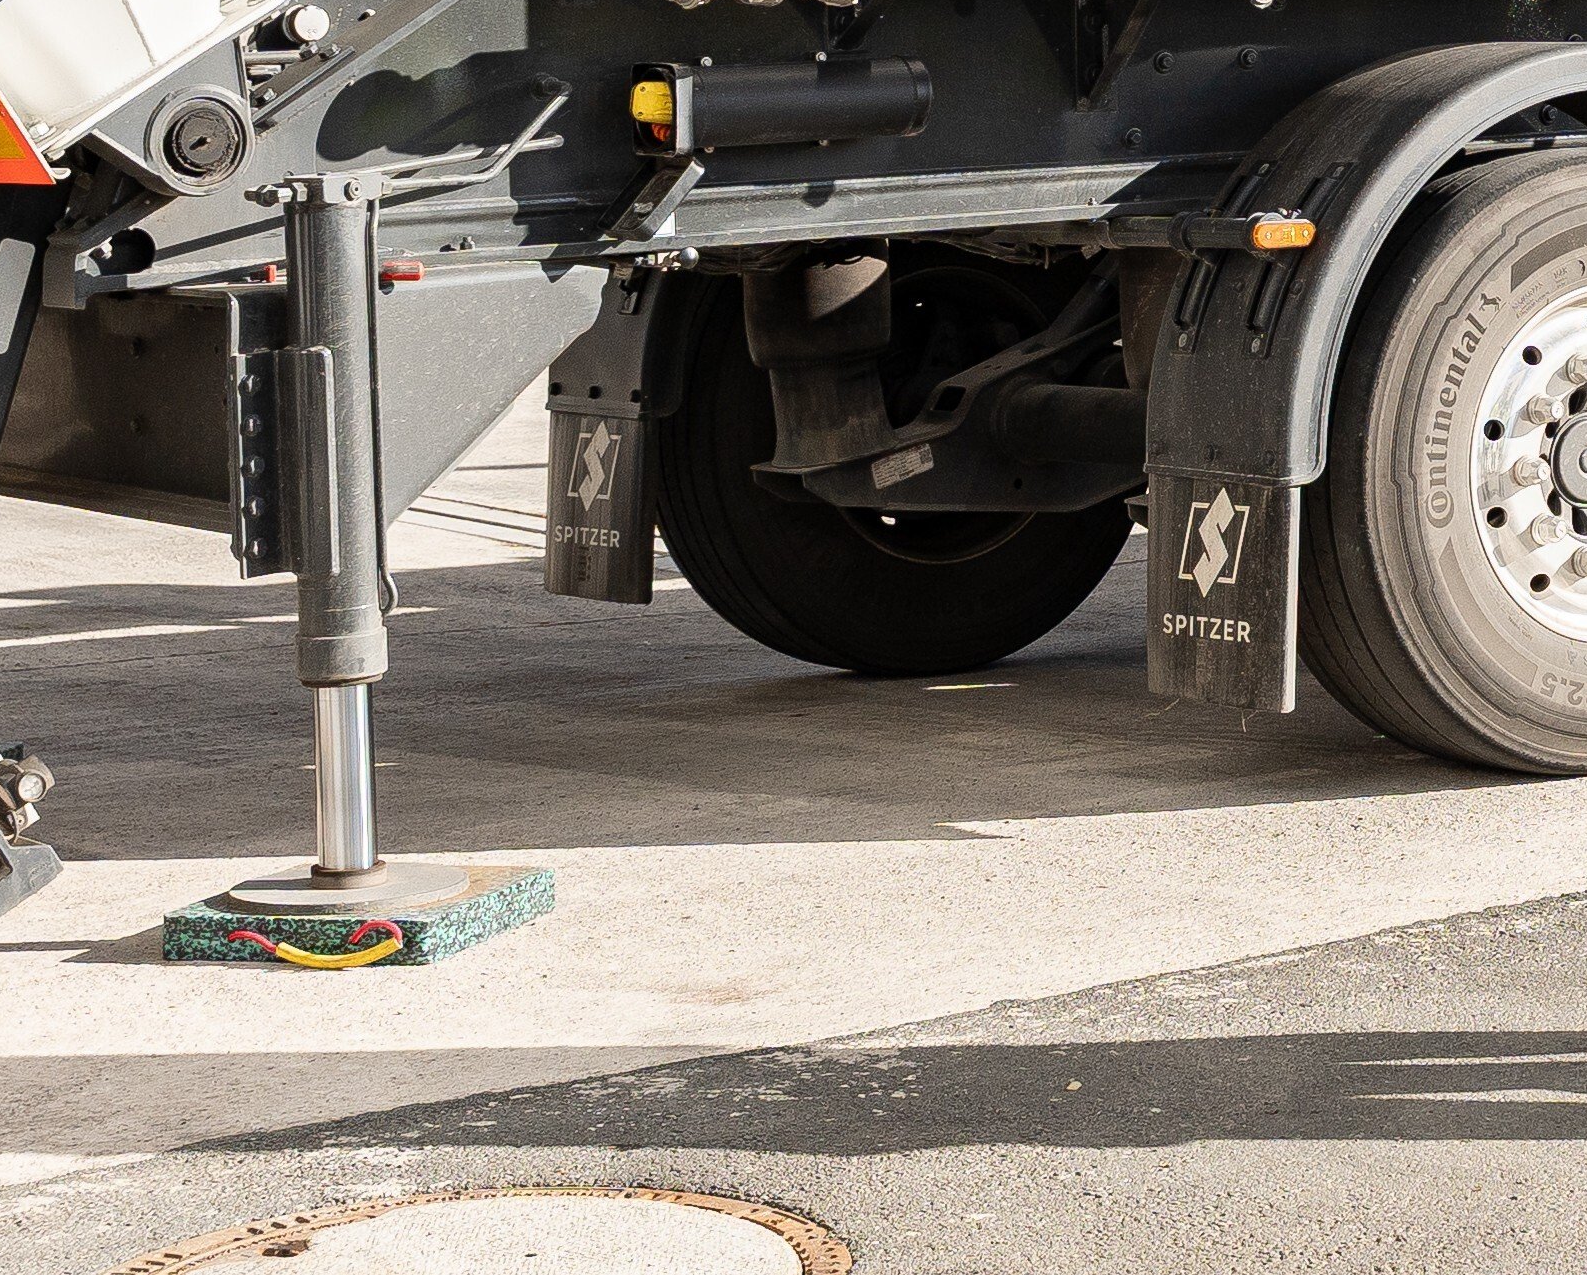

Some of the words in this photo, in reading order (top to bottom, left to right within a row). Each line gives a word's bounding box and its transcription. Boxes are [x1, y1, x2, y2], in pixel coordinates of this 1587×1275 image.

[1425, 312, 1487, 528] Continental
[554, 524, 620, 548] SPITZER
[1162, 610, 1252, 644] SPITZER
